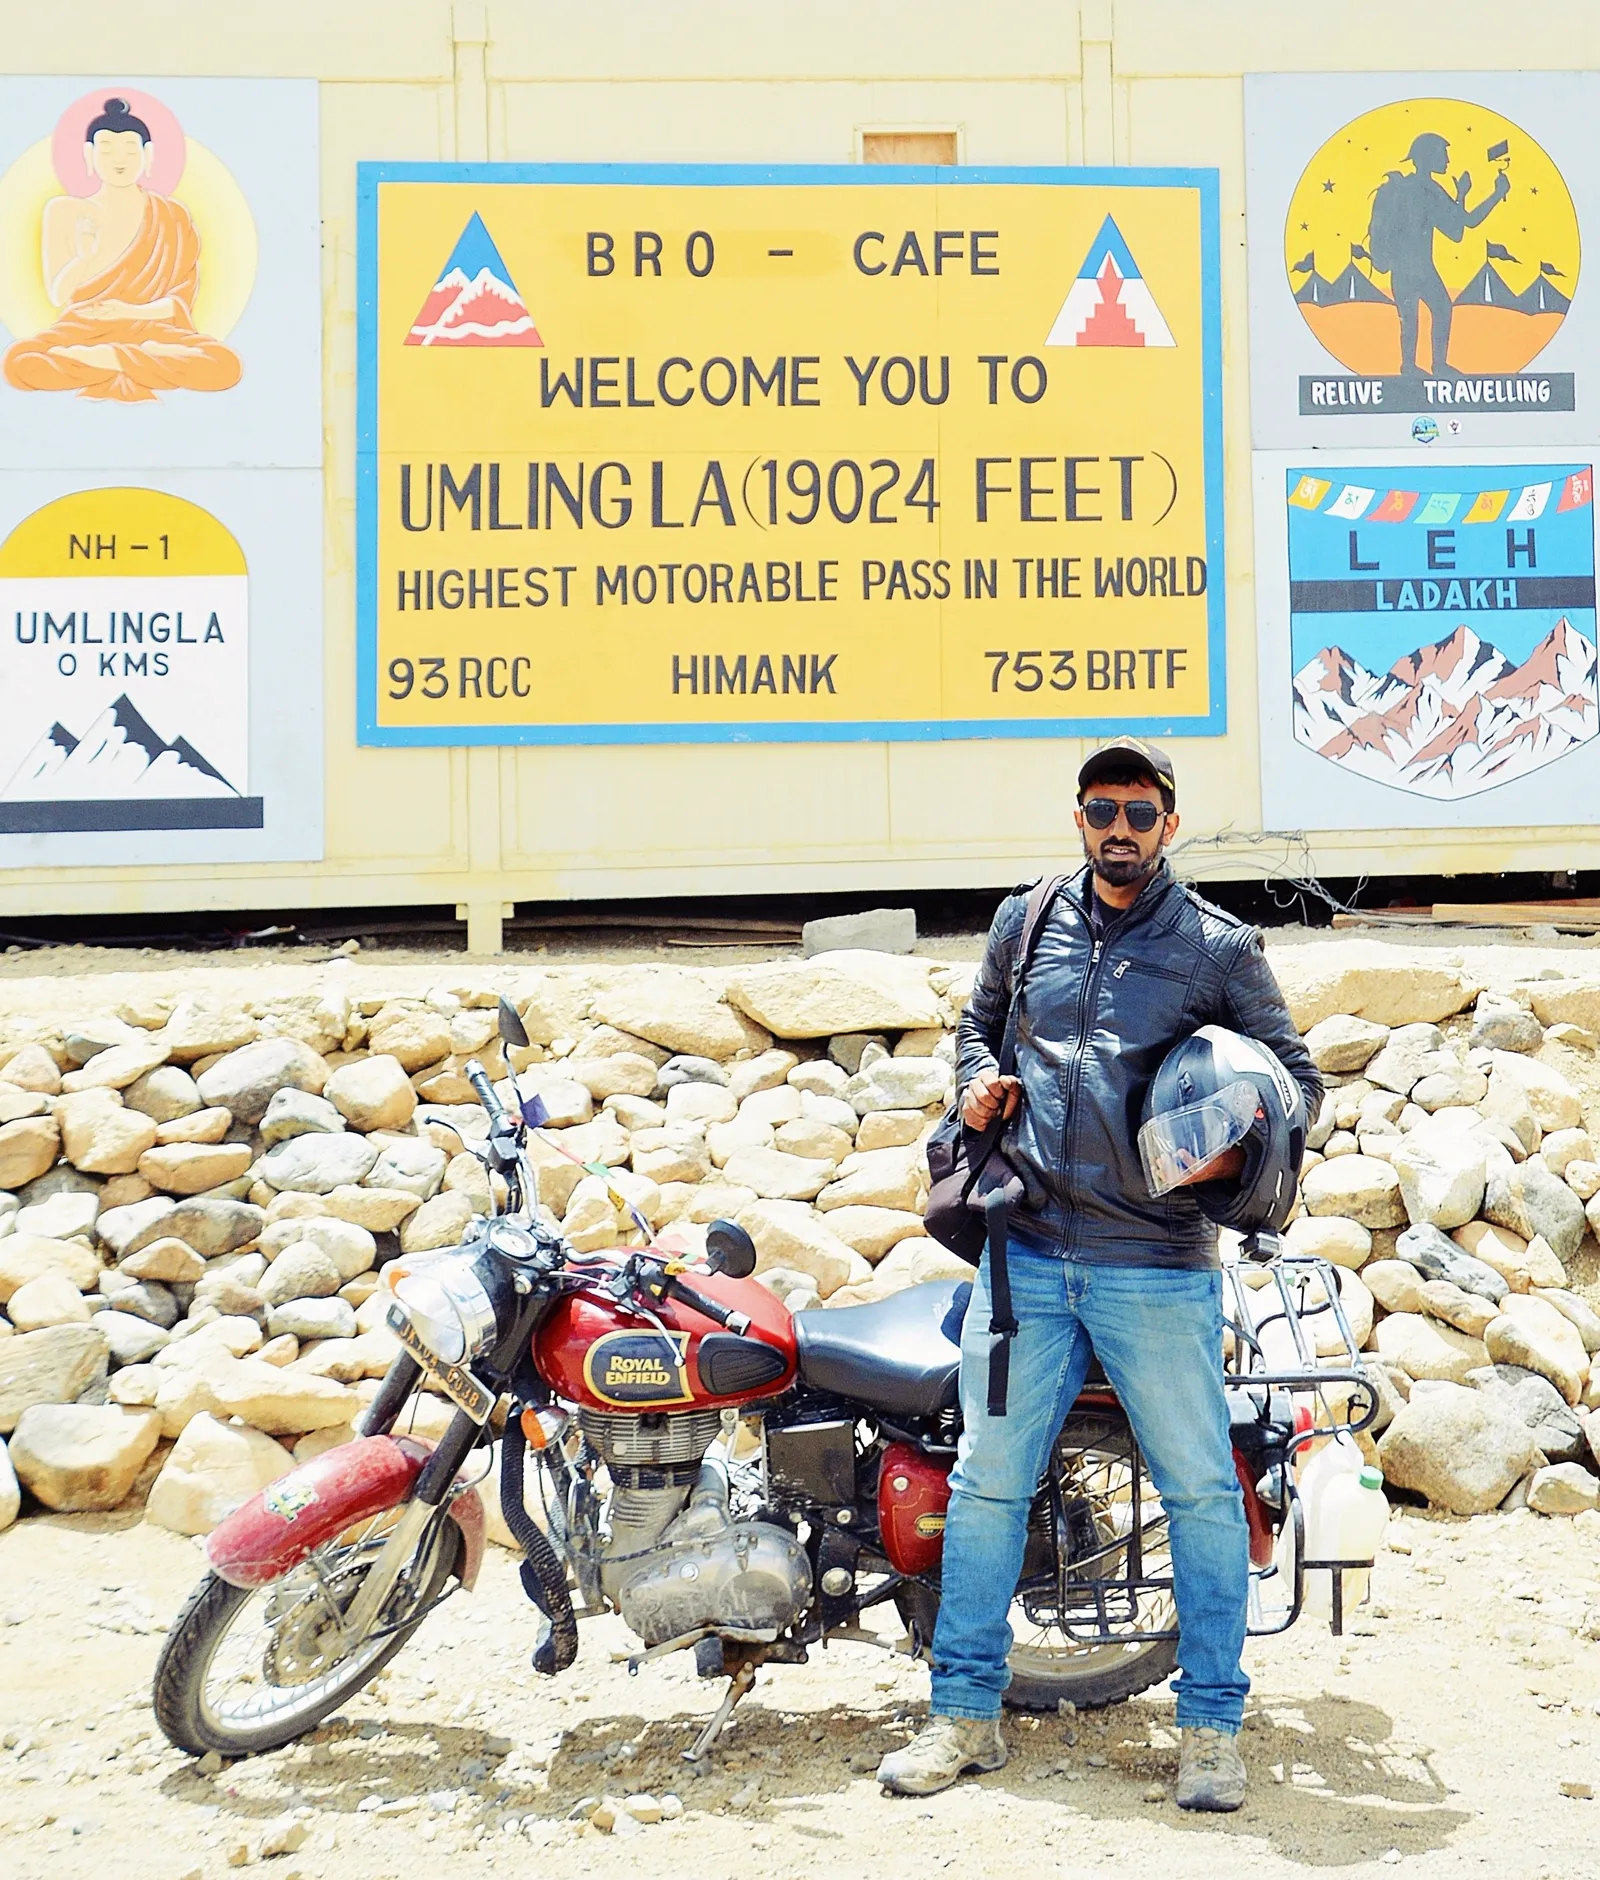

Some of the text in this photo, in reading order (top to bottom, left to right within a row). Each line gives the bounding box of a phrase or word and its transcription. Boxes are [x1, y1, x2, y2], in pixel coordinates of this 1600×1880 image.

[587, 230, 715, 278] BRO
[853, 230, 1000, 277] CAFE
[540, 355, 1048, 409] WELCOME YOU TO
[1311, 379, 1551, 405] RELIVE TRAVELLING
[401, 461, 633, 532] UMLING
[975, 451, 1178, 526] FEET)
[69, 534, 116, 560] NH
[159, 534, 169, 560] 1
[1348, 528, 1537, 571] LEH
[398, 556, 1208, 612] HIGHEST MOTORABLE PASS IN THE WORLD
[1376, 579, 1518, 610] LADAKH
[16, 611, 225, 644] UMLINGLA
[100, 652, 169, 677] KMS
[388, 648, 1188, 700] 93 RCC HIMANK 753 BRTF
[605, 1371, 671, 1385] ENFIELD
[610, 1355, 664, 1372] ROYAL
